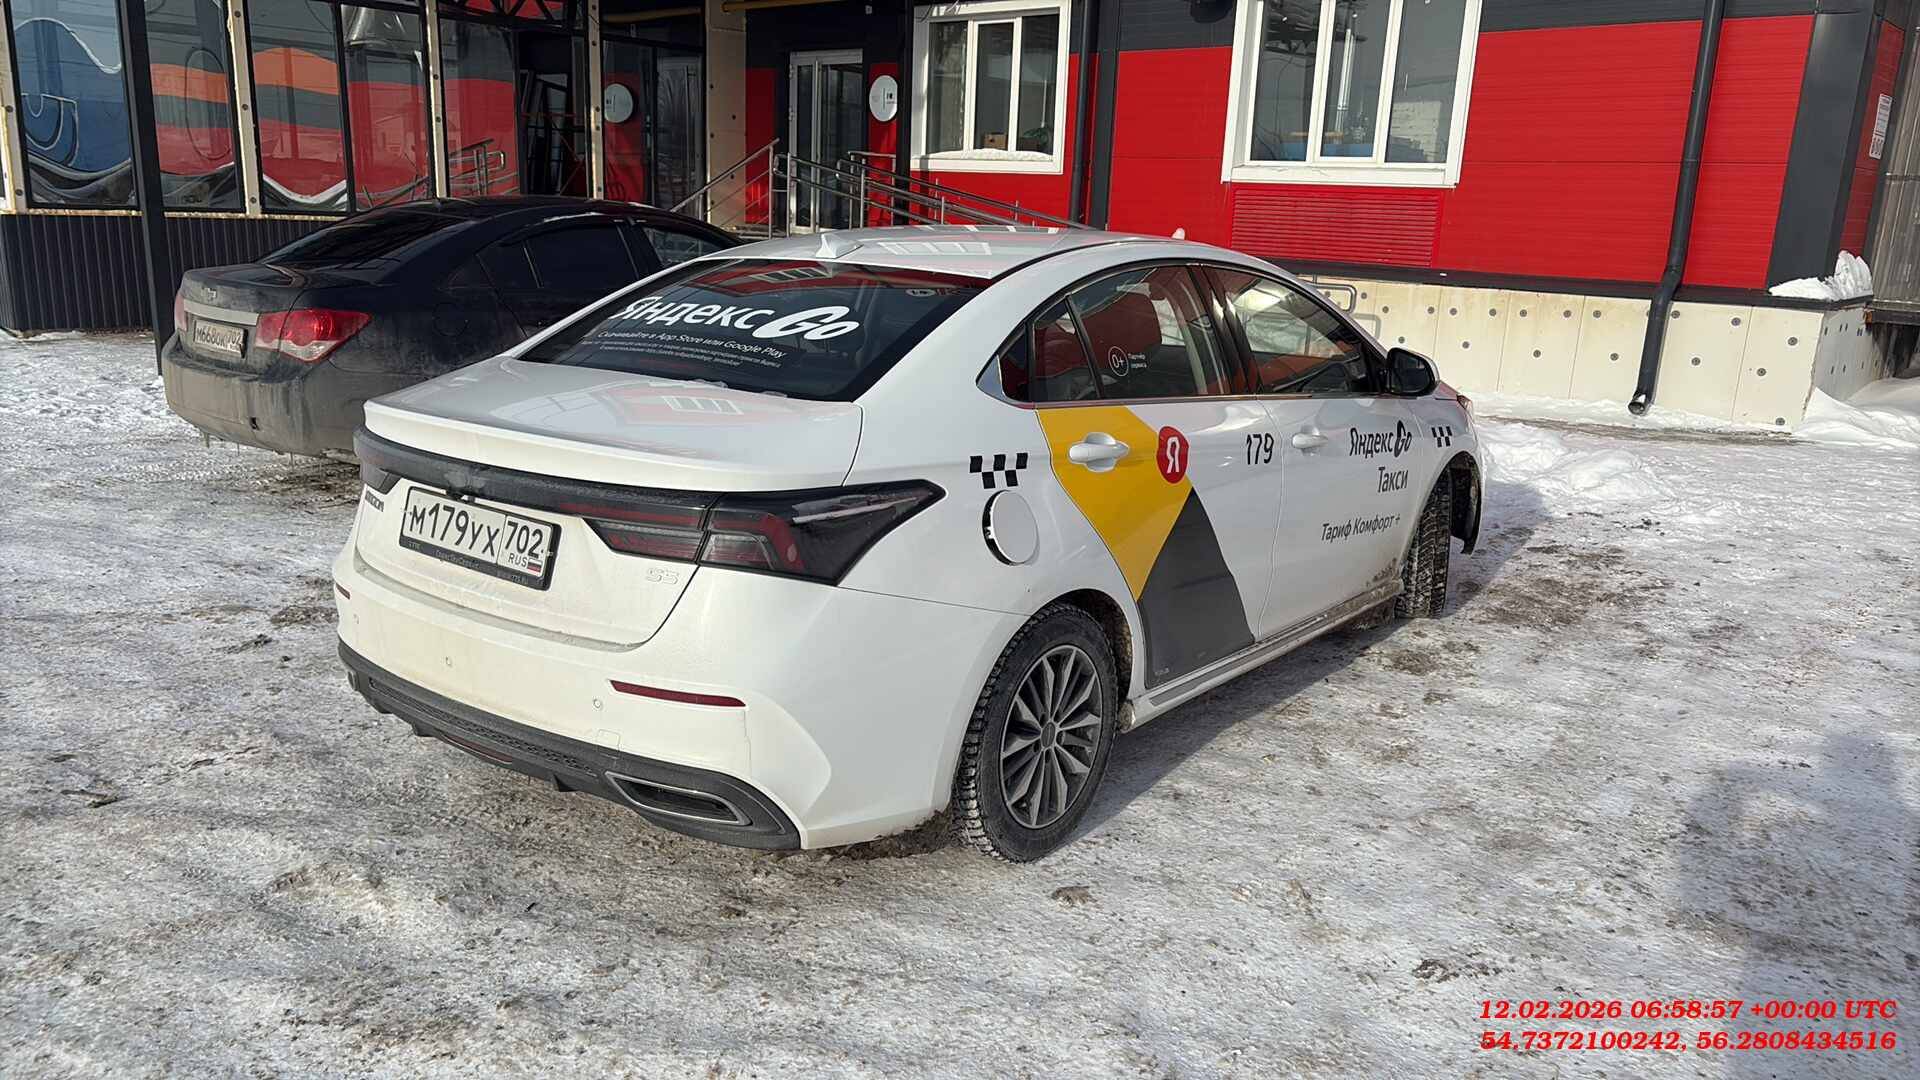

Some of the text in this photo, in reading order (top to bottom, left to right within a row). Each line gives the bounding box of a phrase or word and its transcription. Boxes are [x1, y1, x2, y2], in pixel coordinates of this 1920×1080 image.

[609, 296, 860, 340] Яндекс Go
[677, 334, 704, 344] Store
[724, 340, 762, 353] Google
[762, 347, 787, 359] Play
[1166, 436, 1180, 474] Я
[1246, 433, 1275, 466] 179
[1349, 420, 1412, 458] Яндекс Go
[1377, 466, 1409, 495] Такси
[409, 502, 500, 558] М179УХ
[505, 520, 544, 559] 702
[1321, 520, 1351, 543] Тариф
[508, 552, 528, 568] RUS
